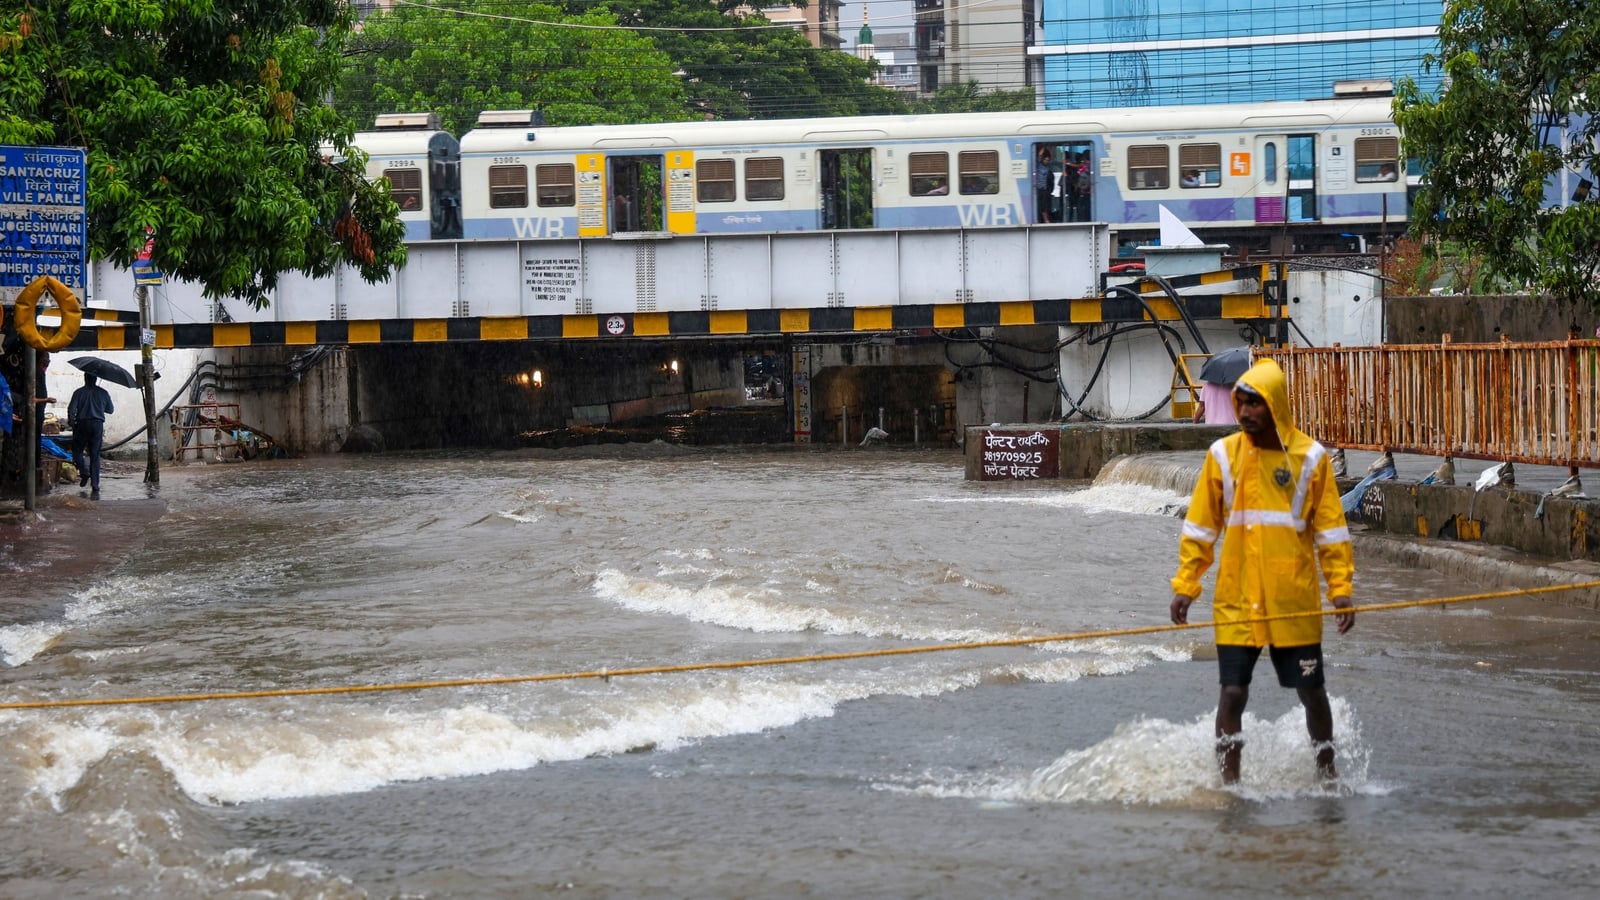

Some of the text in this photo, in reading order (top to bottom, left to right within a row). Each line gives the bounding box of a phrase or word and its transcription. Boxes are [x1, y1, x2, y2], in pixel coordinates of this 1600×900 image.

[0, 166, 81, 179] SANTACRUZ
[2, 191, 81, 204] VILE PARLE
[0, 221, 81, 233] JOGESHWARI
[511, 216, 564, 238] WR
[30, 233, 81, 245] STATION
[37, 263, 81, 275] SPORTS
[984, 451, 1042, 464] 9819709925
